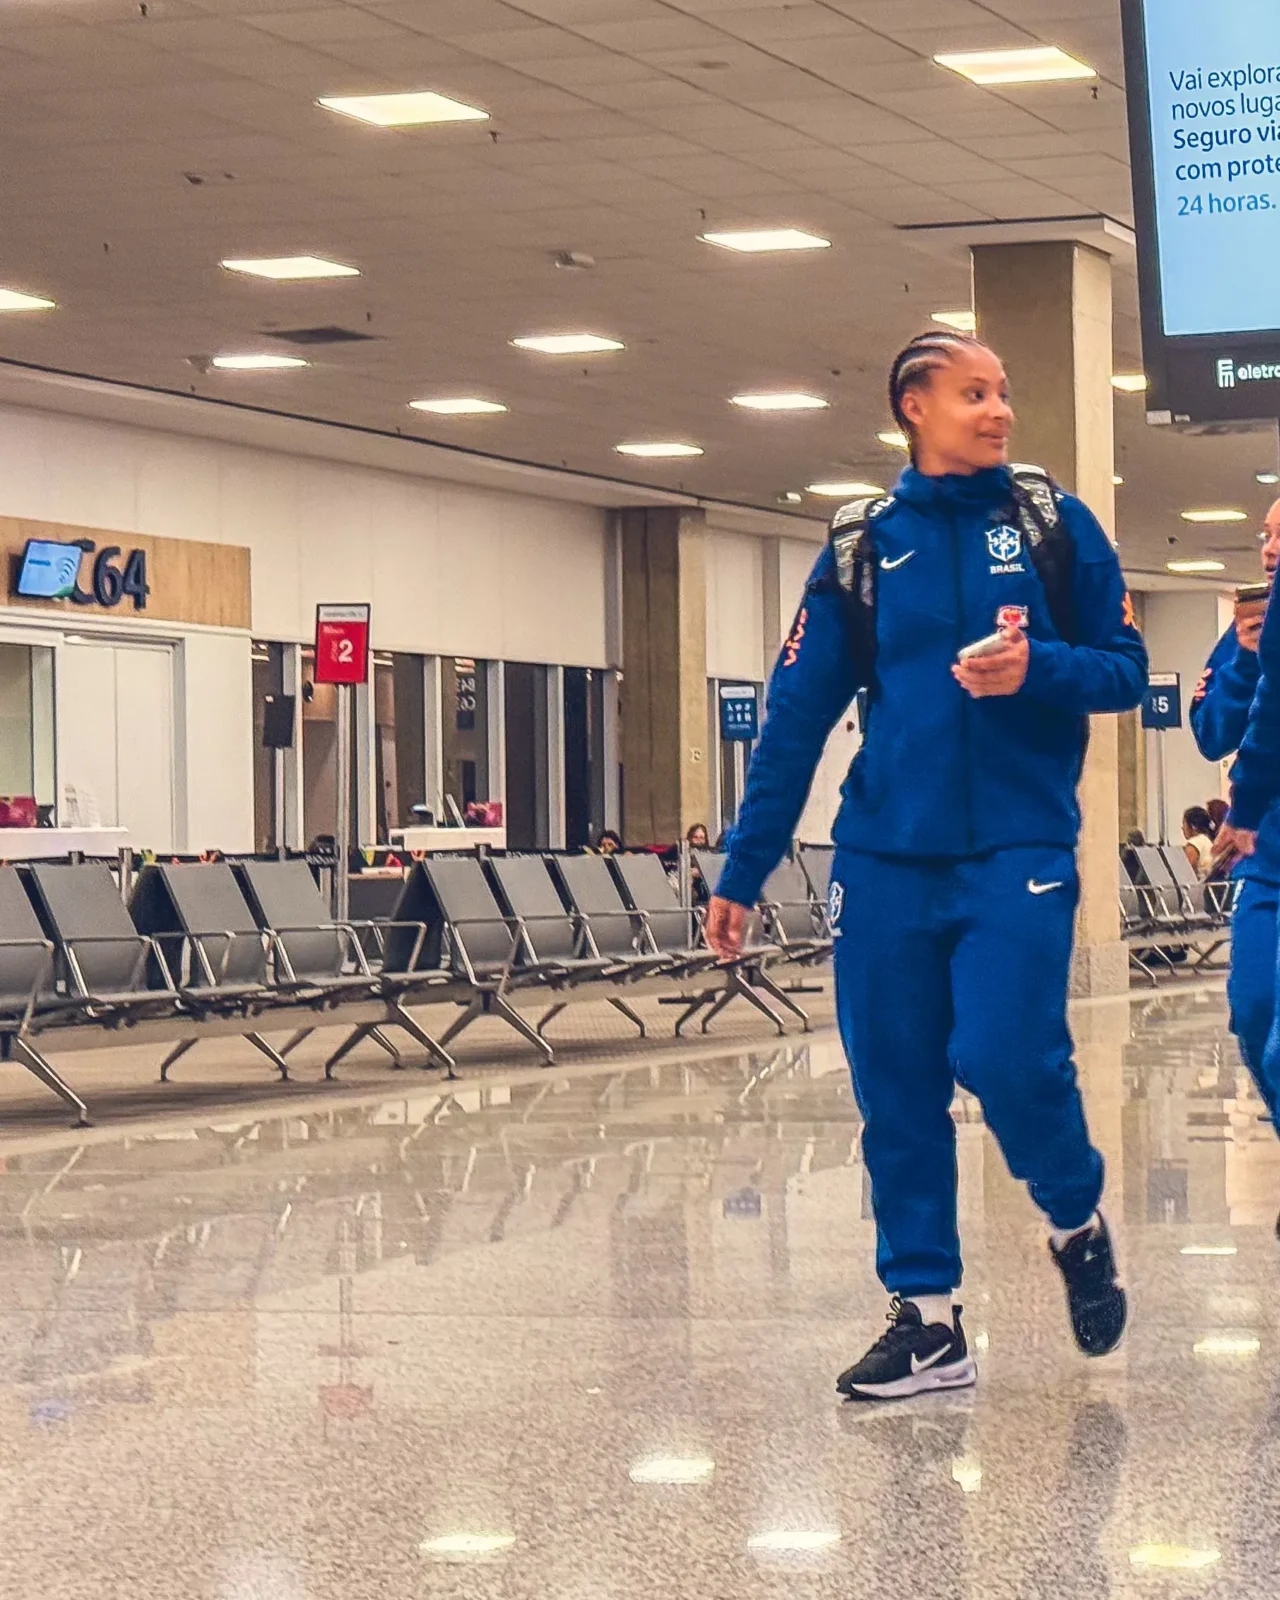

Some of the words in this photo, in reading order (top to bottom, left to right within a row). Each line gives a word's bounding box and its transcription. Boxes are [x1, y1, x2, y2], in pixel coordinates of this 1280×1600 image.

[1169, 67, 1204, 92] Vai
[1171, 97, 1236, 120] novos
[1173, 127, 1252, 152] Seguro
[1175, 161, 1222, 181] com
[1177, 195, 1204, 217] 24
[1208, 193, 1277, 214] horas.
[990, 563, 1025, 574] BRASIL
[338, 639, 354, 663] 2
[1157, 695, 1169, 714] 5
